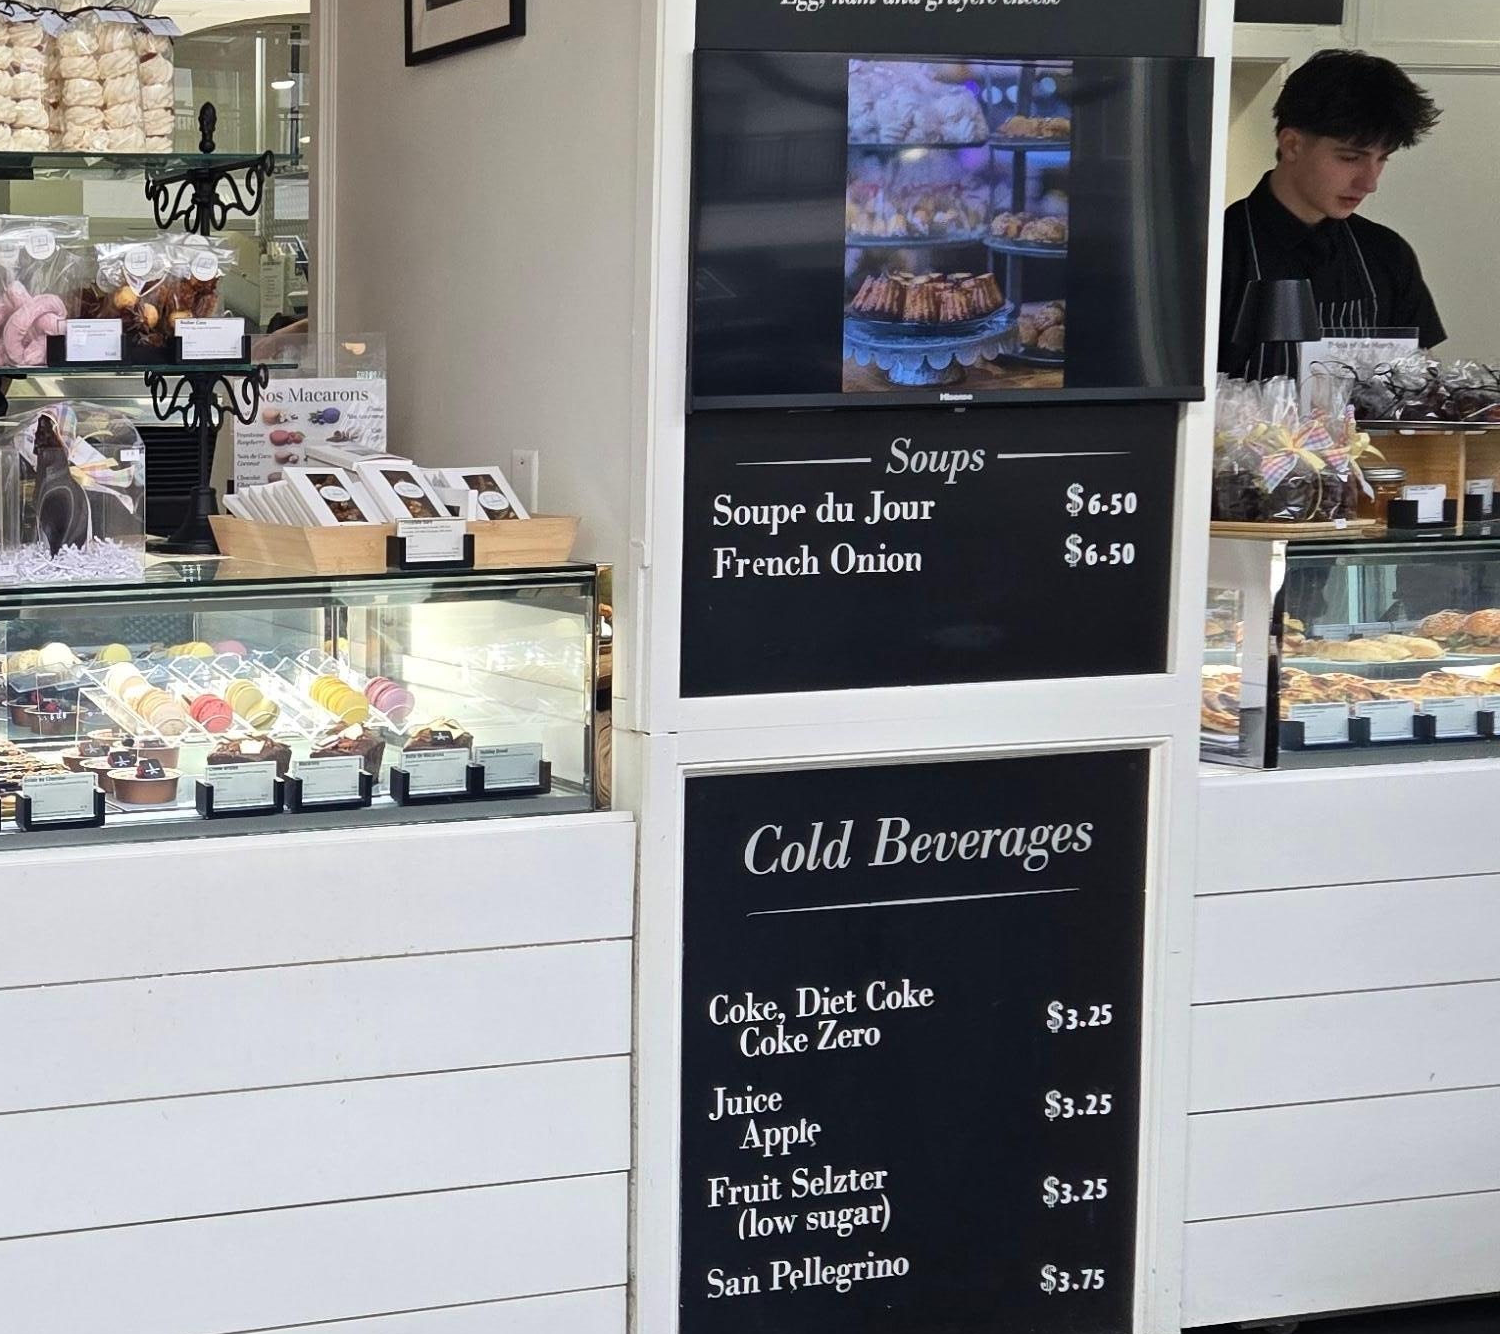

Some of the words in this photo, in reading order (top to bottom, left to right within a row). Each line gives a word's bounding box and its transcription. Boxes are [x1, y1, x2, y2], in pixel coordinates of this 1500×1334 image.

[288, 388, 369, 402] Macarons
[886, 438, 985, 484] Soups
[713, 492, 807, 535] Soupe
[816, 492, 855, 522] du
[865, 491, 935, 524] Jour
[1066, 483, 1137, 516] $6.50
[713, 545, 820, 578] French
[831, 543, 921, 574] Onion
[1065, 534, 1134, 567] $6.50
[745, 820, 853, 874] Cold
[868, 817, 1093, 871] Beverages
[710, 993, 785, 1025] Coke,
[796, 987, 856, 1017] Diet
[867, 979, 934, 1011] Coke
[1047, 1001, 1112, 1033] $3.25
[740, 1025, 808, 1057] Coke
[817, 1020, 880, 1049] Zero
[709, 1086, 782, 1120] Juice
[1045, 1090, 1111, 1121] $3.25
[739, 1118, 821, 1157] Apple
[708, 1175, 782, 1207] Fruit
[792, 1165, 887, 1197] Selzter
[1043, 1176, 1107, 1207] $3.25
[739, 1208, 798, 1240] (low
[807, 1194, 890, 1237] sugar)
[708, 1269, 760, 1298] San
[769, 1251, 910, 1294] Pellegrino
[1040, 1264, 1104, 1294] $3.75
